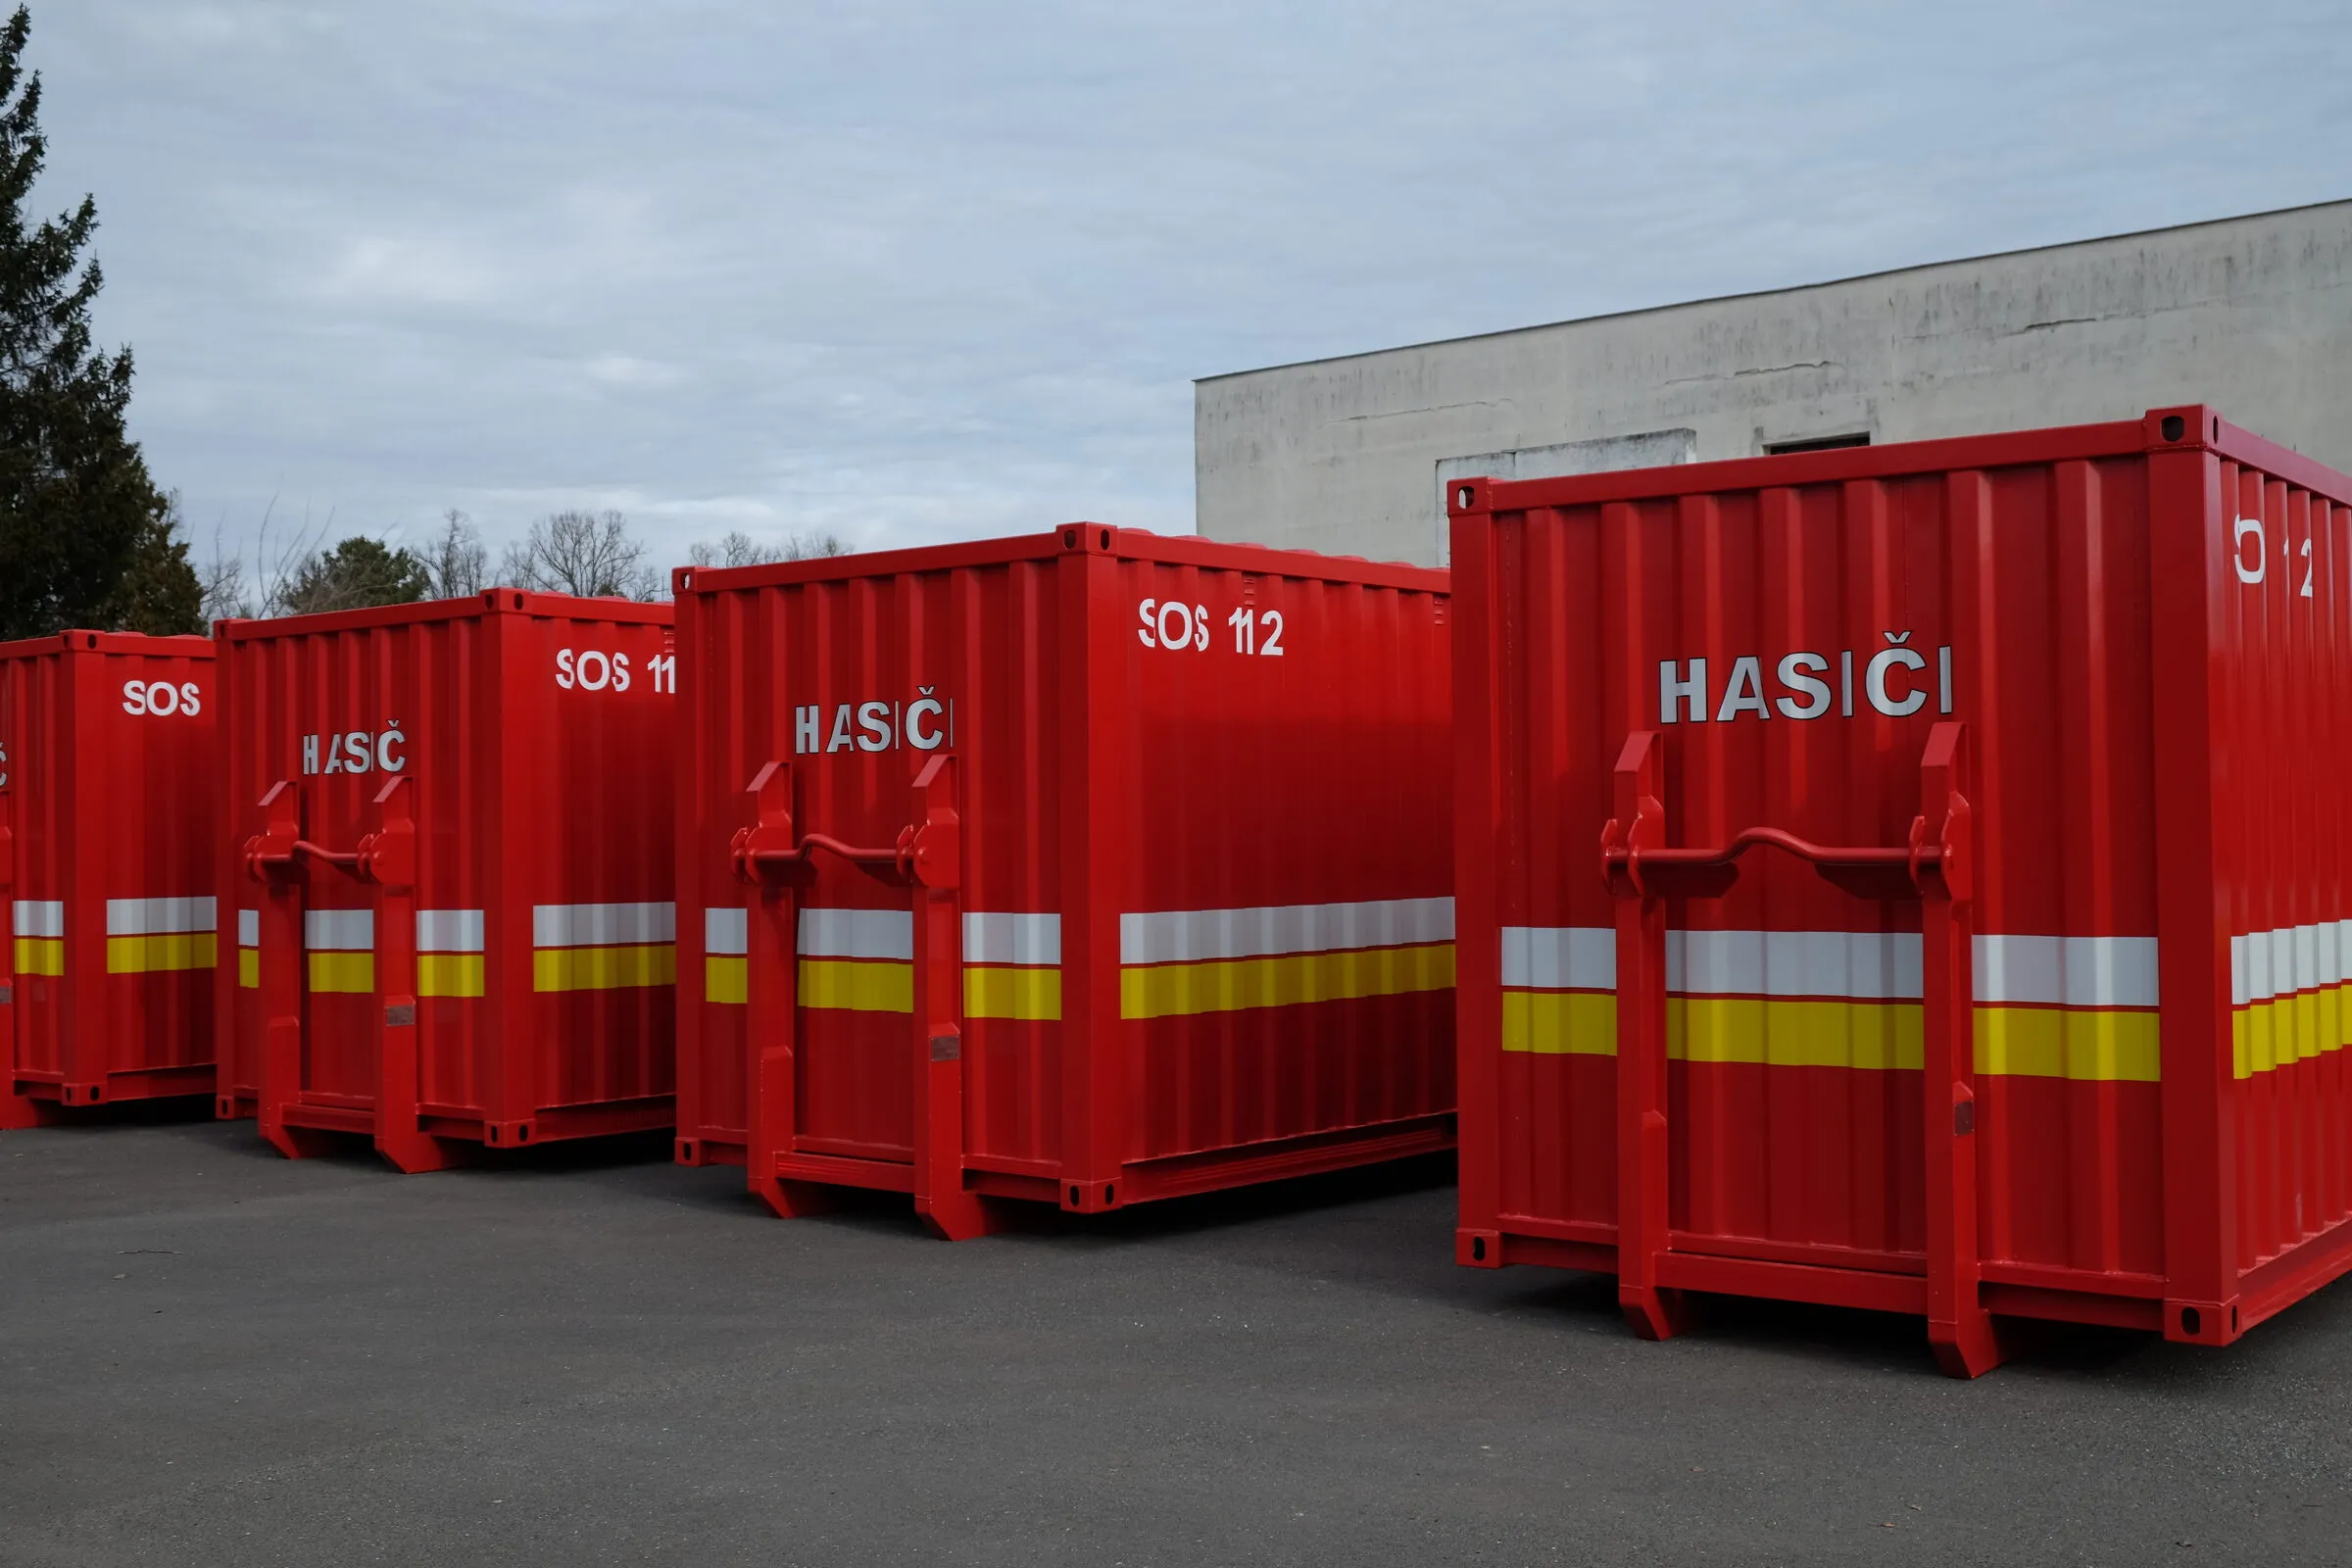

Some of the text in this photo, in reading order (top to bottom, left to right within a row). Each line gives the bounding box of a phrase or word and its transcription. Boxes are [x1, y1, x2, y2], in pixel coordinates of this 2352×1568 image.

[1138, 598, 1284, 657] SOS 112
[555, 648, 675, 694] SOS 11
[1658, 629, 1953, 725] HASIČI
[122, 679, 201, 716] SOS
